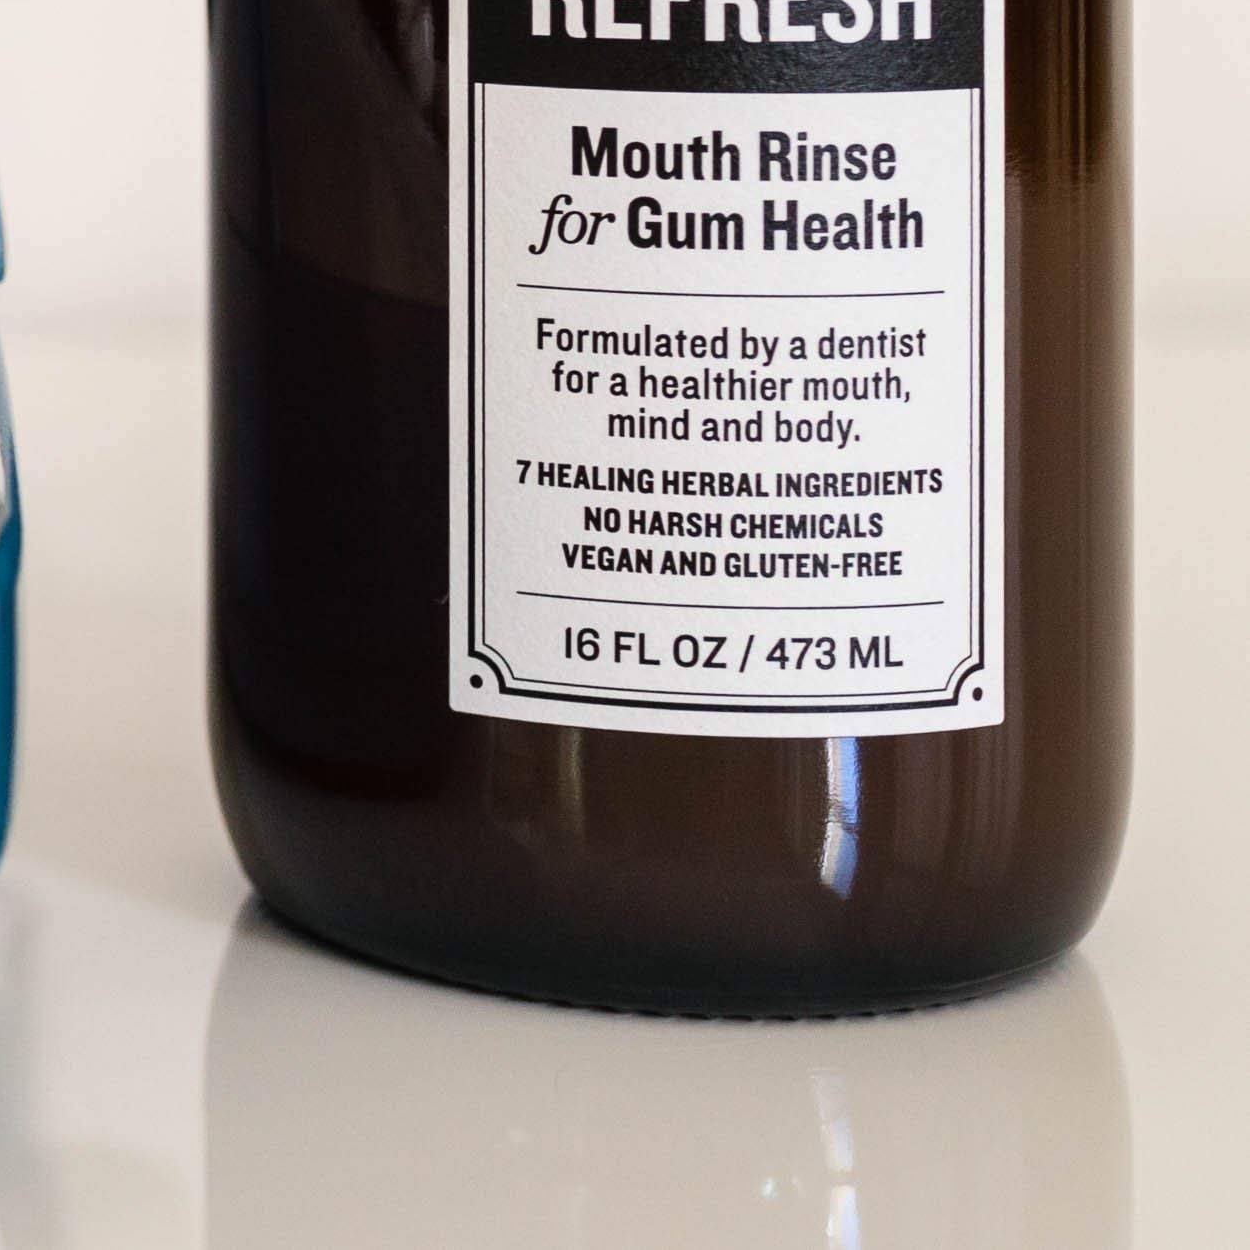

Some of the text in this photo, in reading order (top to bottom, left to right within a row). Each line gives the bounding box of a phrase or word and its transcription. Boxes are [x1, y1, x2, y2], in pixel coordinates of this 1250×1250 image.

[571, 125, 896, 182] Mouth Rinse
[527, 193, 923, 256] for Gum Health
[536, 317, 927, 367] Formulated by a dentist
[551, 359, 910, 403] for a healthier mouth,
[608, 407, 860, 450] mind and body.
[516, 459, 943, 498] 7 HEALING HERBAL INGREDIENTS
[583, 505, 883, 540] NO HARSH CHEMICALS
[561, 542, 903, 579] VEGAN AND GLUTEN-FREE
[564, 626, 904, 673] 16 FL OZ / 473 ML
